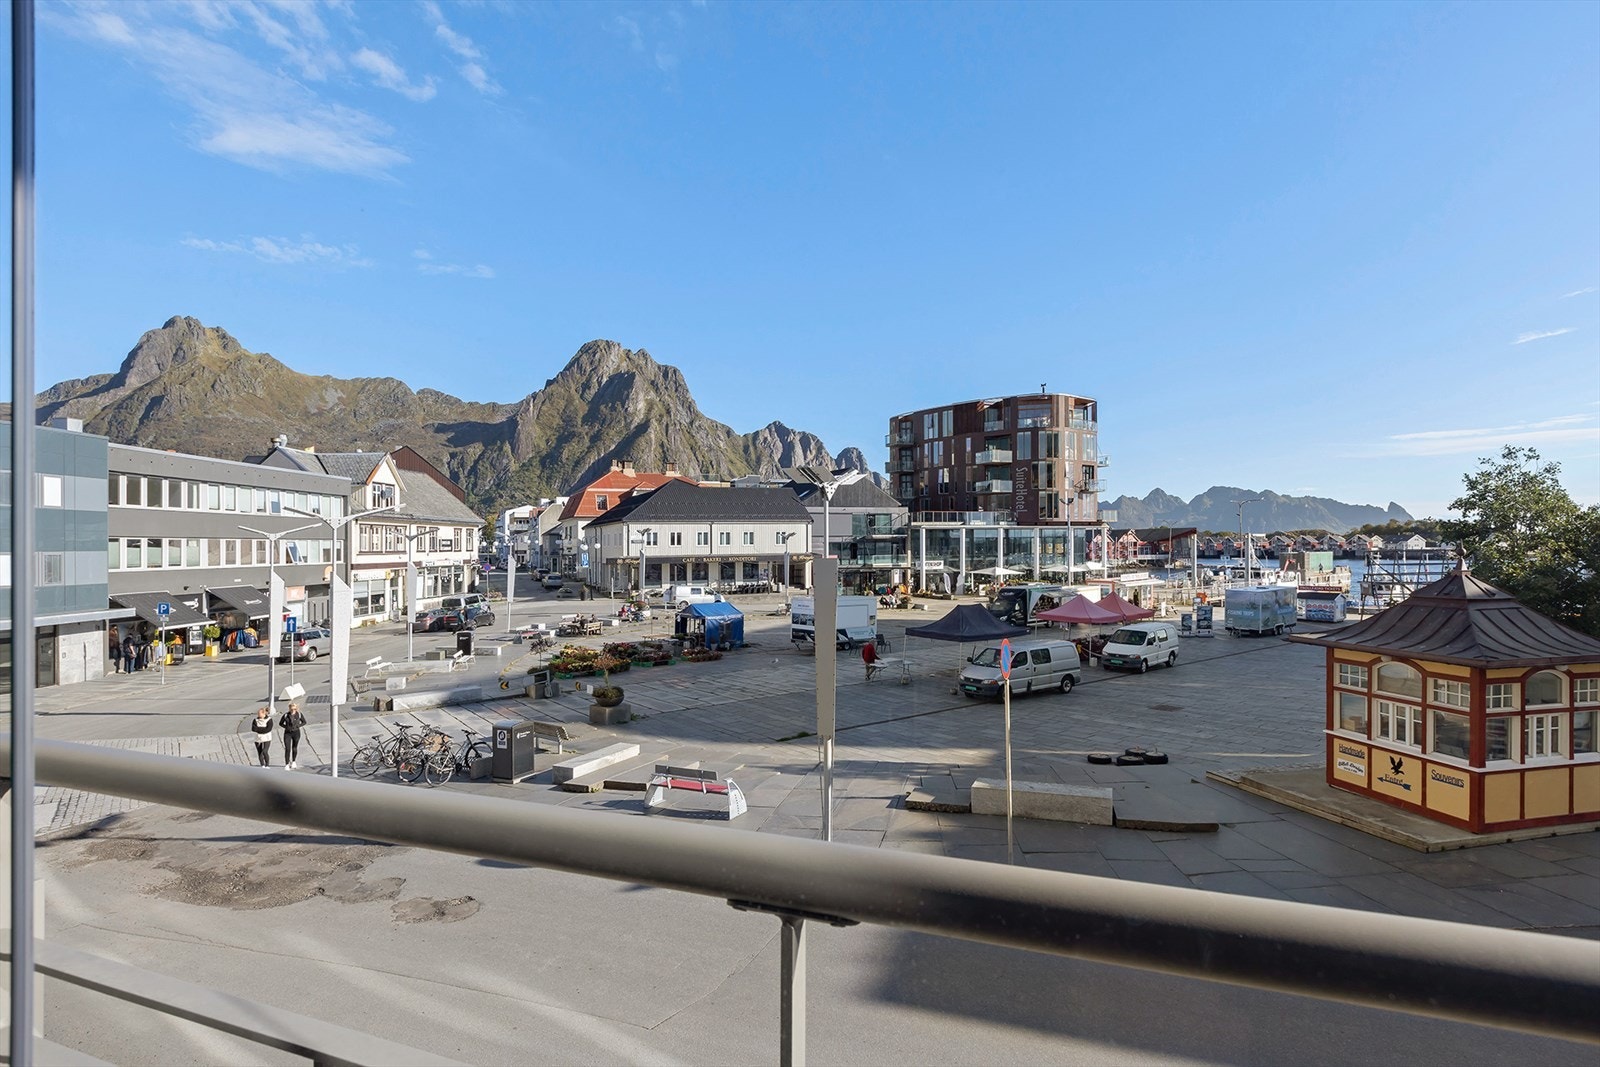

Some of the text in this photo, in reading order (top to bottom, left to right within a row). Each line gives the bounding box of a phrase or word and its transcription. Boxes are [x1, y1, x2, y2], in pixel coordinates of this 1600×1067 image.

[1015, 466, 1028, 513] SuiteHotel
[160, 604, 168, 612] P
[1338, 744, 1365, 758] Handmade
[1431, 769, 1465, 787] Souvenirs
